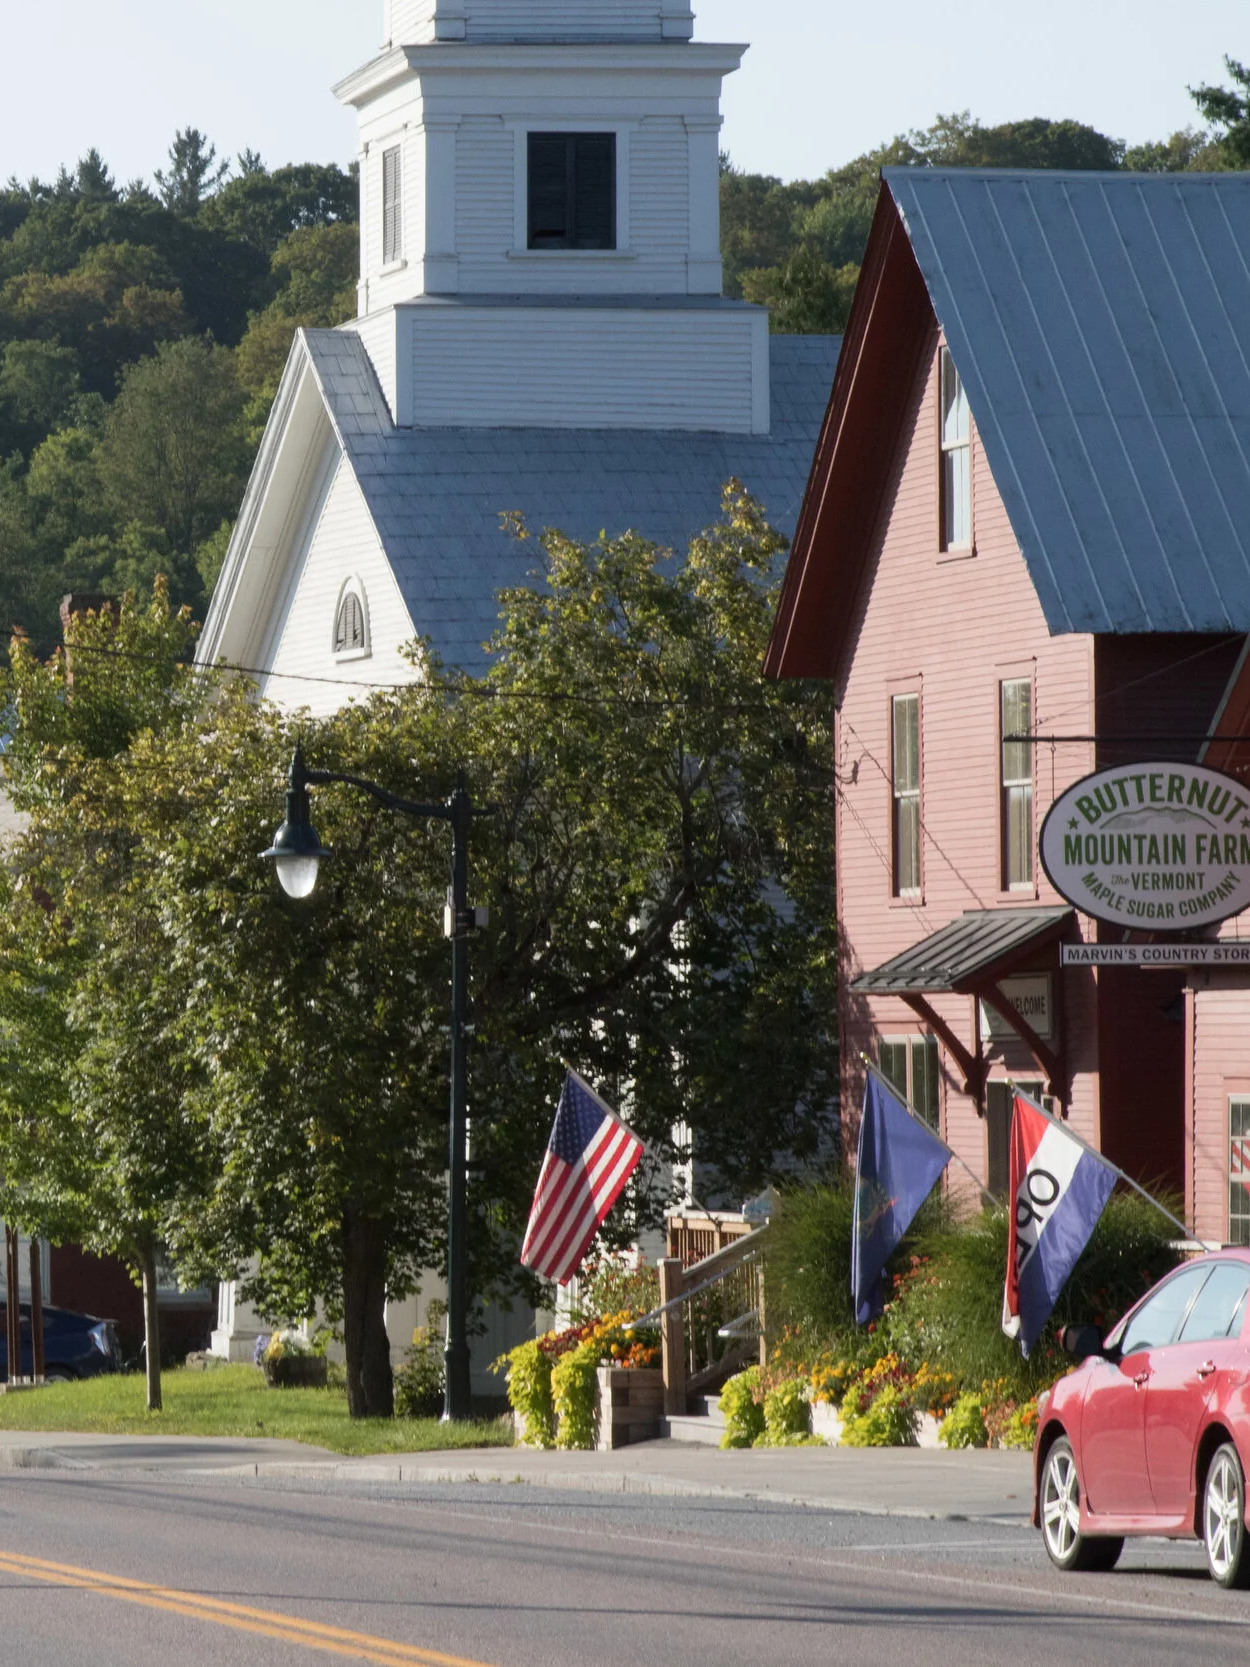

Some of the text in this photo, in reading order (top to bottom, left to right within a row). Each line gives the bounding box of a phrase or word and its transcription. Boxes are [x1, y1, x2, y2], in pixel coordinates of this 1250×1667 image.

[1074, 773, 1249, 825] BUTTERNUT
[1064, 833, 1186, 866] MOUNTAIN
[1081, 870, 1242, 919] MAPLE SUGAR COMPANY
[1110, 872, 1206, 891] The VERMONT
[1067, 948, 1138, 961] MARVIN'S
[1142, 948, 1209, 961] COUNTRY
